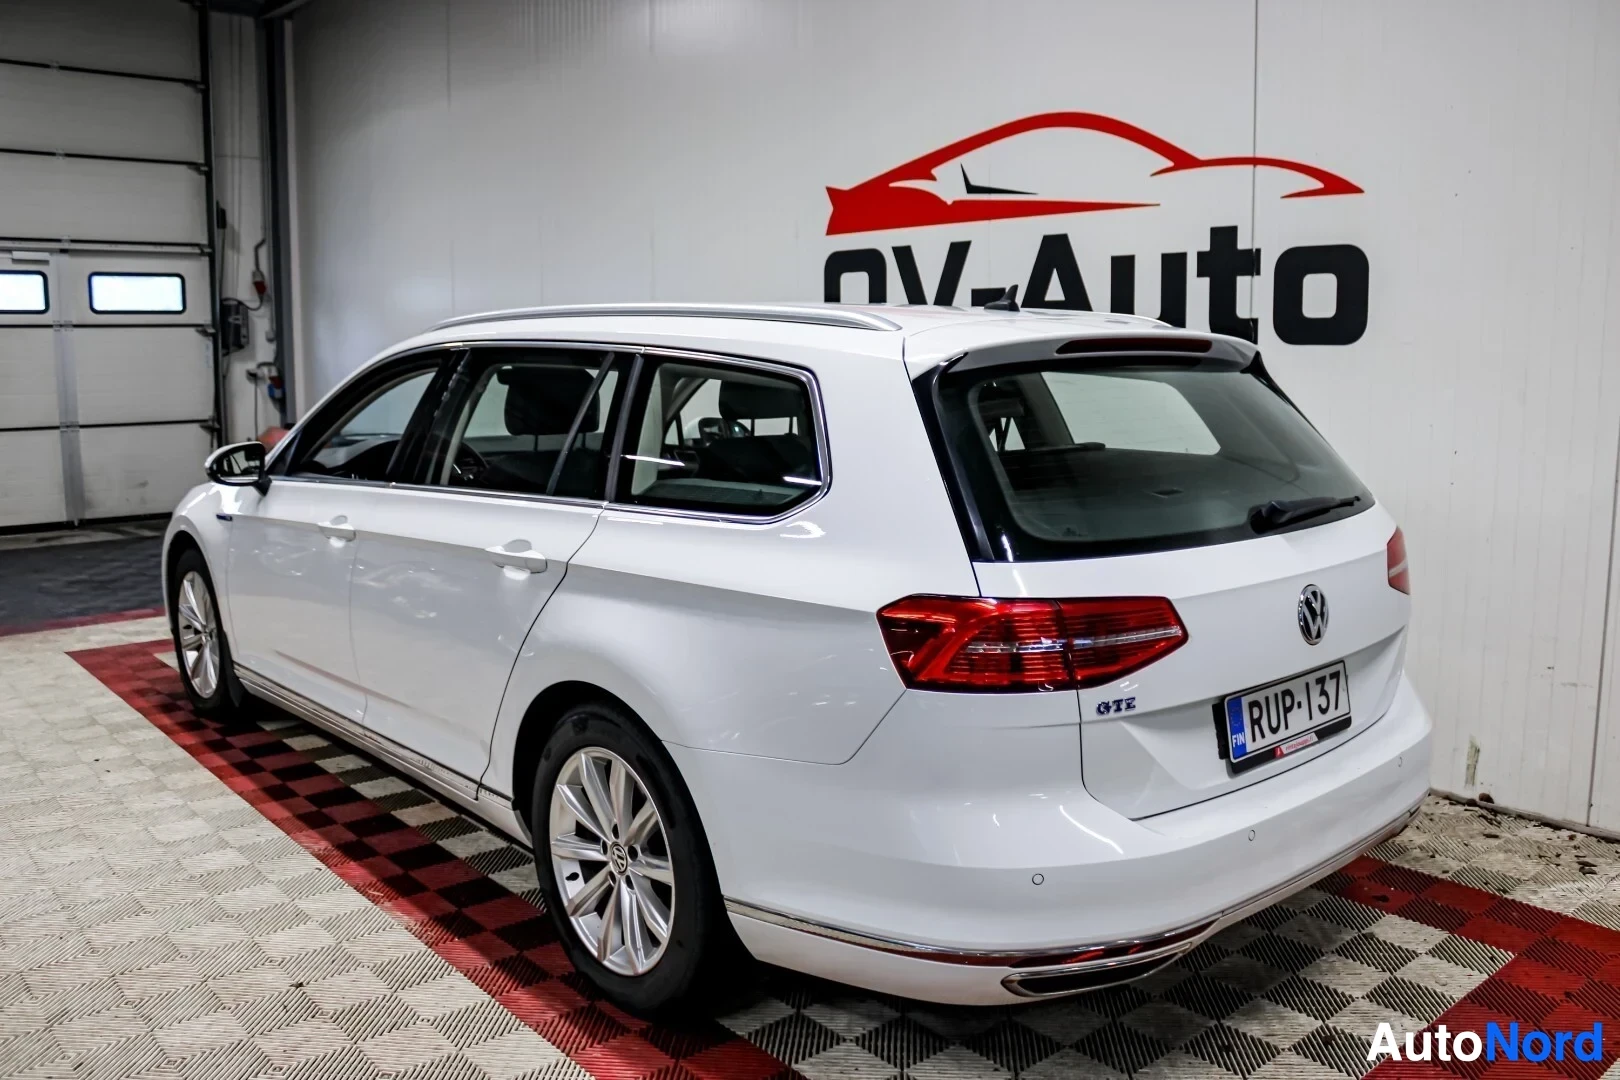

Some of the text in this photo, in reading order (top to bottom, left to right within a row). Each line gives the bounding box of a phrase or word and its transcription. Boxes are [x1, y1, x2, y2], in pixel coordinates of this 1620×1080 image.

[1096, 697, 1136, 715] GTE
[1248, 670, 1341, 743] RUP-137
[1232, 732, 1246, 748] FIN
